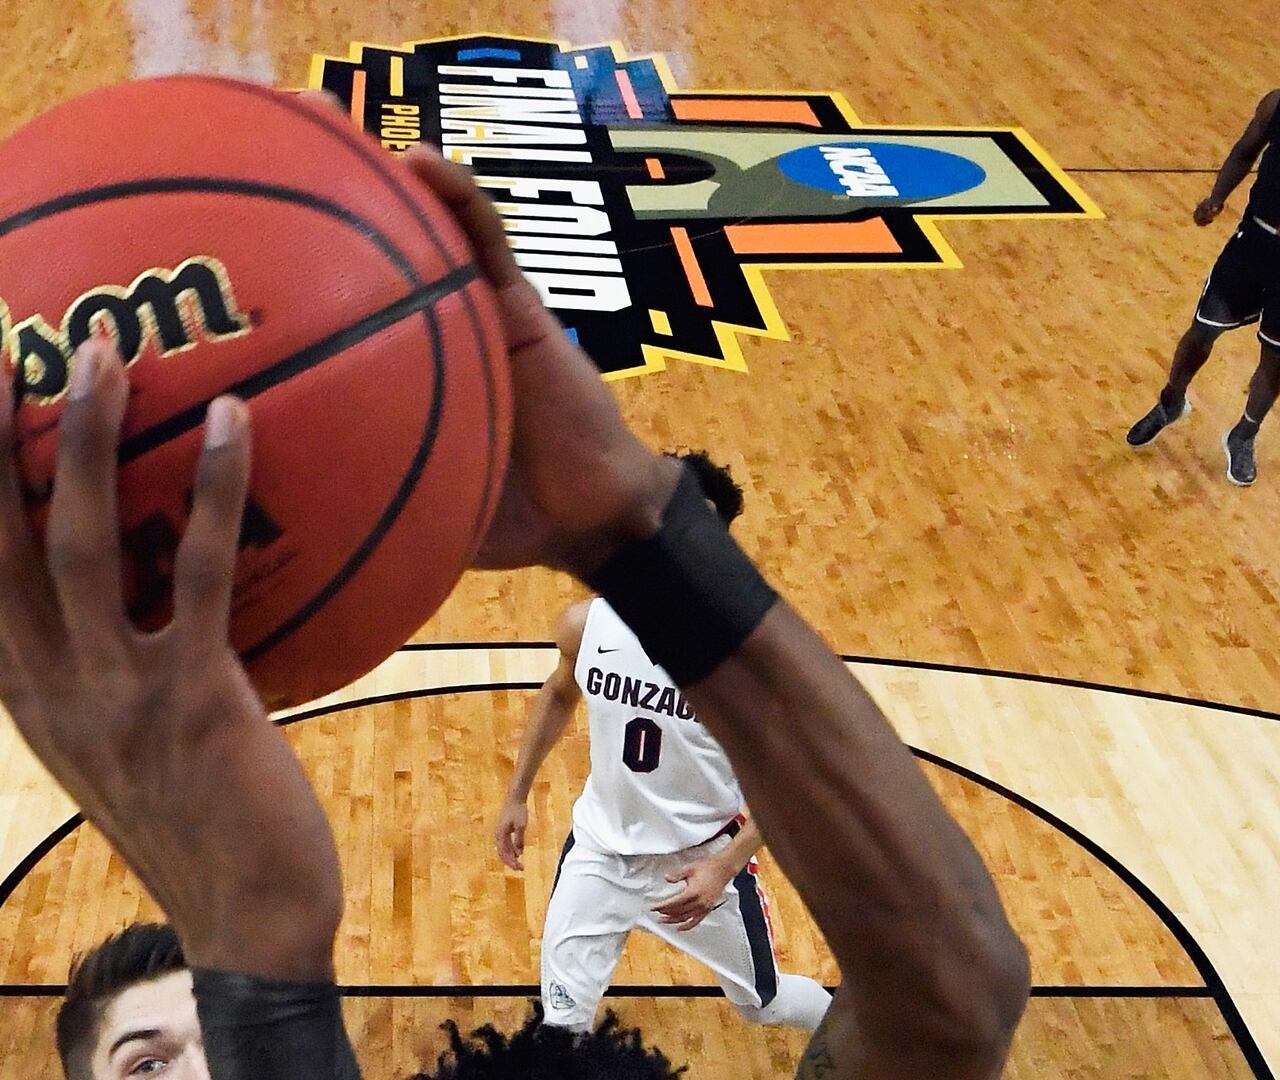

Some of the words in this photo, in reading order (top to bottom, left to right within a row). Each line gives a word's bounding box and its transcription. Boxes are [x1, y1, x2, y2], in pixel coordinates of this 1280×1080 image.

[437, 65, 594, 166] FINAL
[818, 146, 900, 197] NCAA
[586, 666, 701, 723] GONZAG
[622, 716, 663, 773] 0
